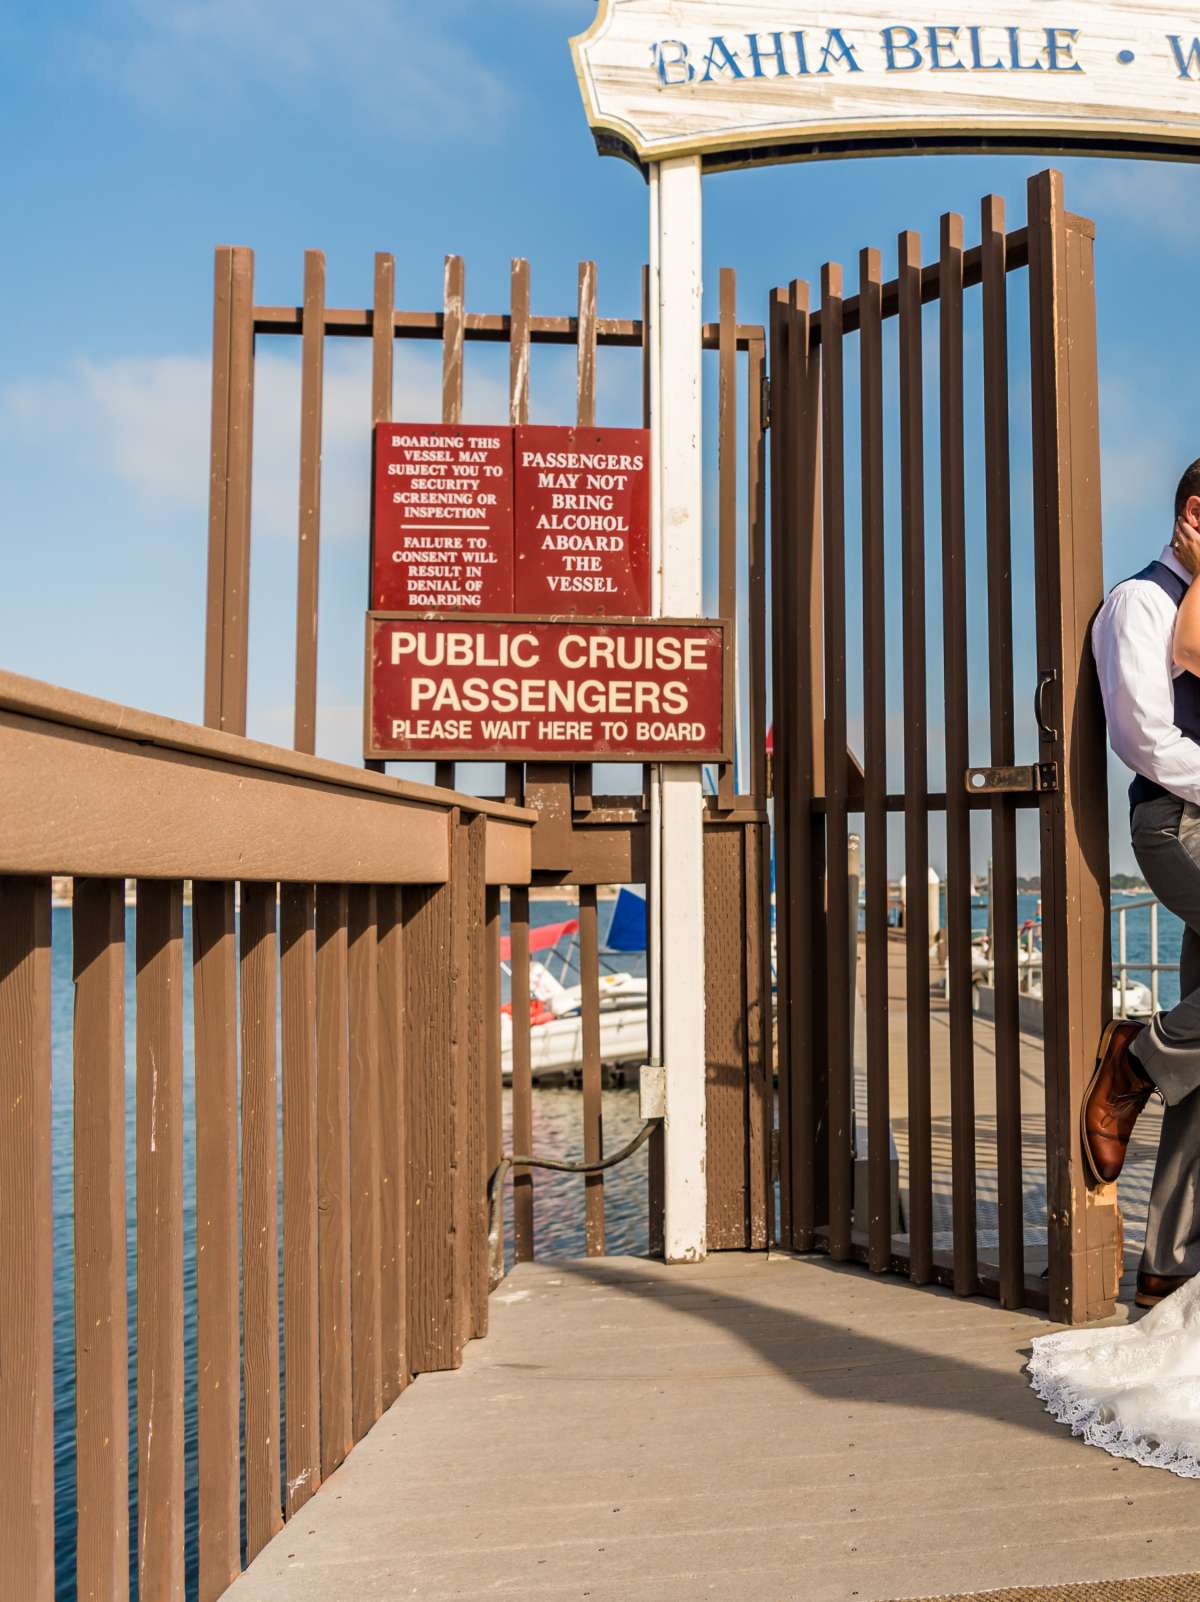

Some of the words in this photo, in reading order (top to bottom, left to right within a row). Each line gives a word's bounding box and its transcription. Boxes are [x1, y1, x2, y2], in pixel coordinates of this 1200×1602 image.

[650, 26, 864, 88] BAHIA
[881, 24, 1086, 75] BELLE
[391, 435, 464, 449] BOARDING
[467, 437, 501, 449] THIS
[403, 449, 455, 462] VESSEL
[458, 451, 488, 463] MAY
[522, 451, 644, 471] PASSENGERS
[387, 463, 448, 476] SUBJECT
[451, 464, 479, 477] YOU
[482, 465, 504, 477] TO
[410, 478, 480, 491] SECURITY
[538, 473, 581, 489] MAY
[586, 474, 628, 491] NOT
[392, 492, 473, 505] SCREENING
[476, 493, 497, 505] OR
[551, 493, 614, 511] BRING
[404, 506, 487, 519] INSPECTION
[535, 514, 629, 532] ALCOHOL
[403, 536, 463, 549] FAILURE
[466, 537, 488, 549] TO
[541, 535, 624, 552] ABOARD
[391, 550, 458, 563] CONSENT
[461, 551, 498, 564] WILL
[562, 555, 603, 572] THE
[408, 565, 463, 578] RESULT
[466, 566, 482, 578] IN
[407, 579, 462, 592] DENIAL
[464, 580, 483, 592] OF
[546, 575, 618, 593] VESSEL
[408, 594, 482, 606] BOARDING
[391, 631, 540, 668] PUBLIC
[558, 634, 710, 671] CRUISE
[410, 677, 689, 715] PASSENGERS
[392, 719, 473, 740] PLEASE
[480, 720, 531, 740] WAIT
[538, 721, 593, 741] HERE
[600, 721, 628, 741] TO
[636, 721, 706, 741] BOARD
